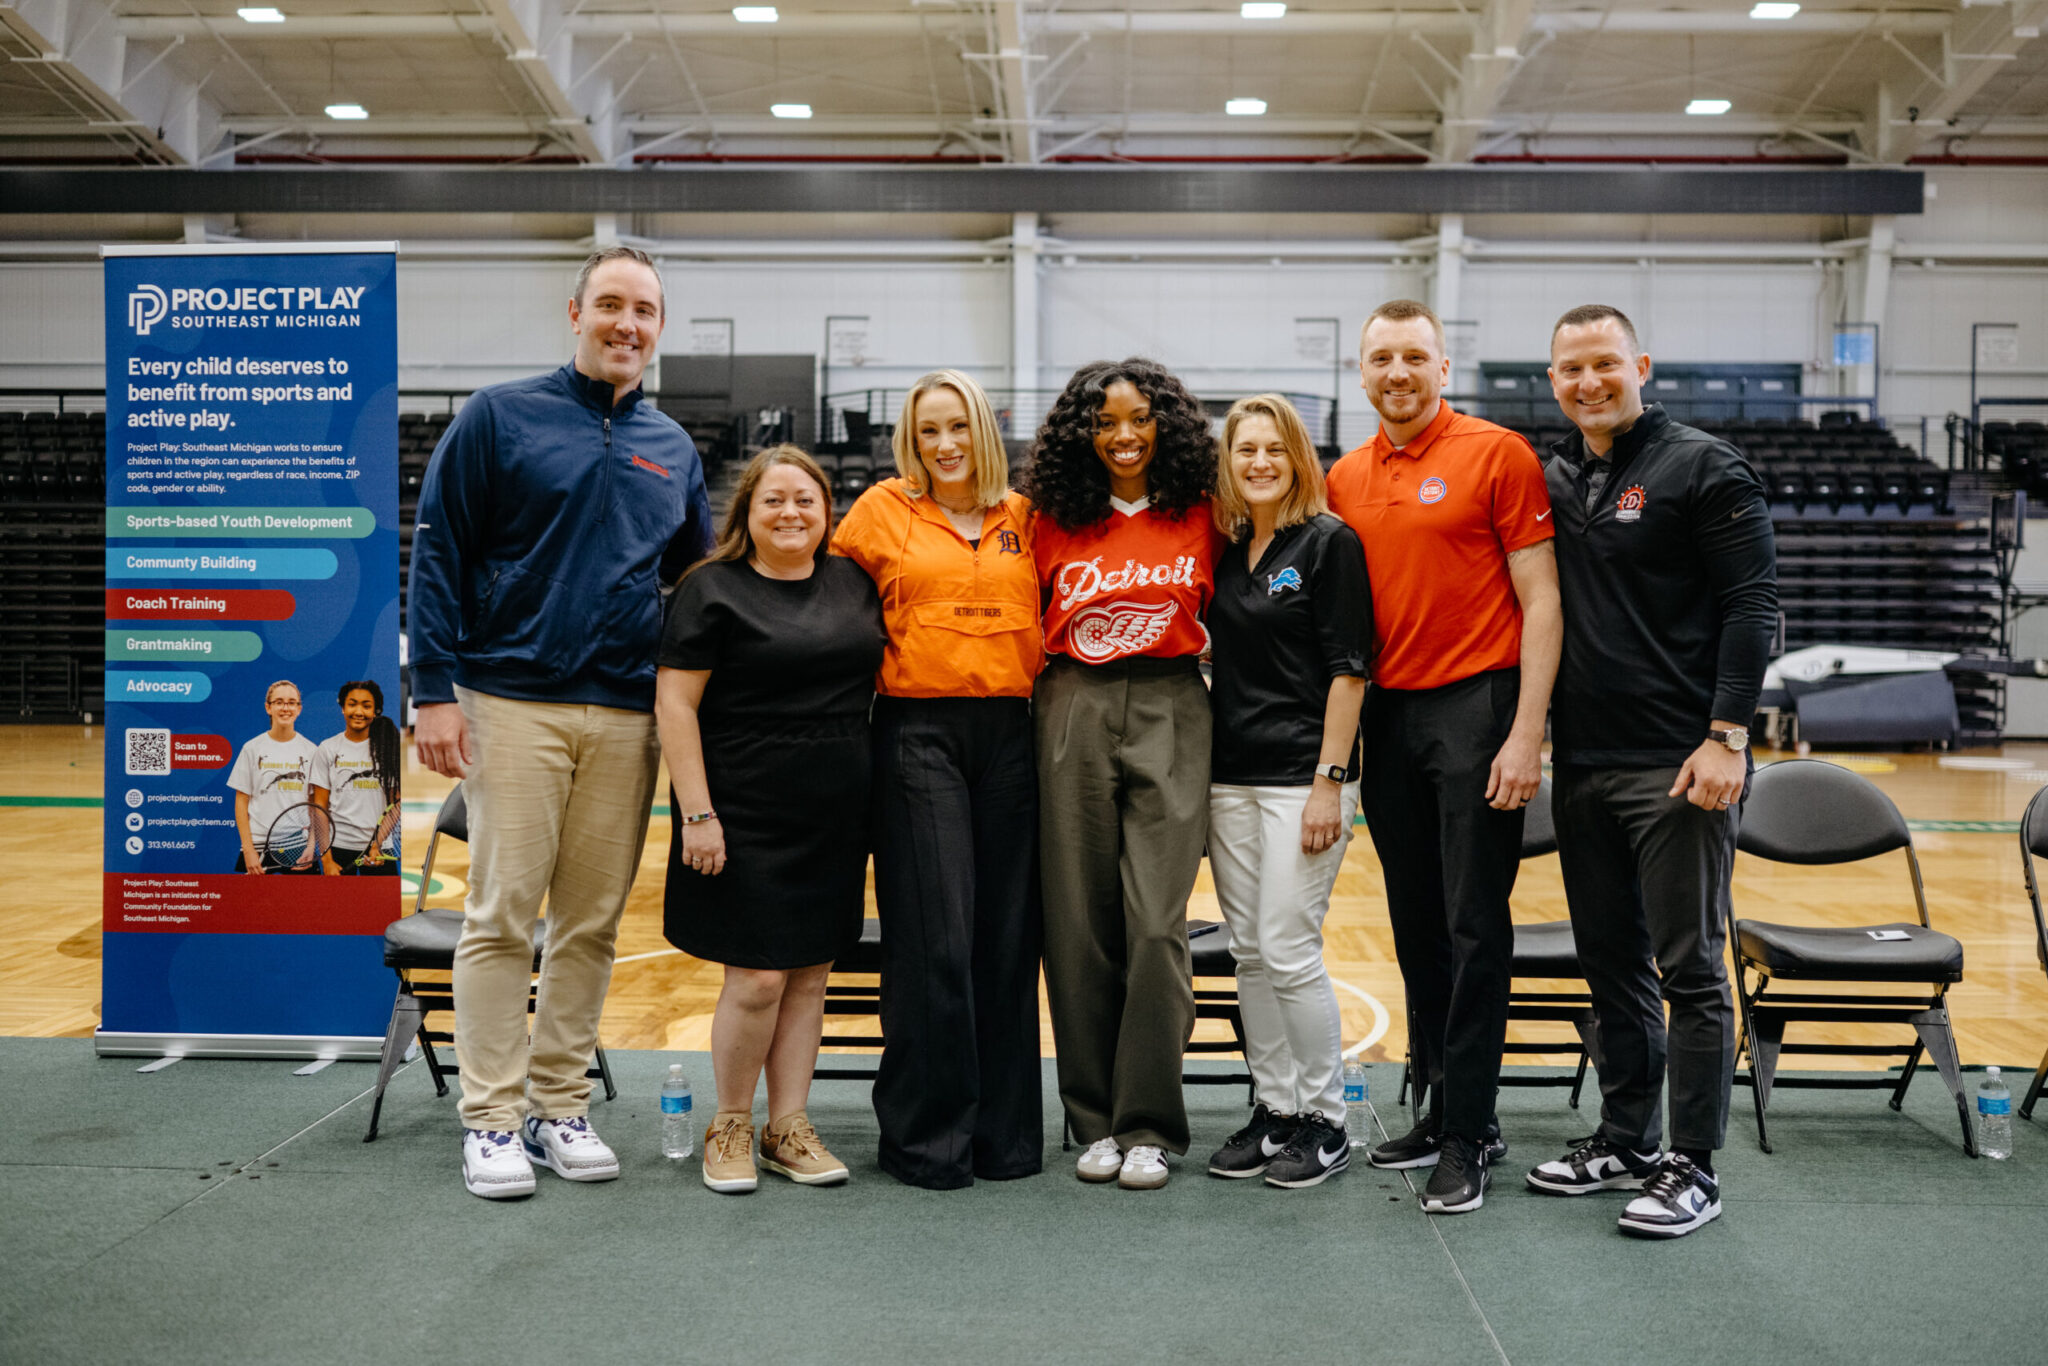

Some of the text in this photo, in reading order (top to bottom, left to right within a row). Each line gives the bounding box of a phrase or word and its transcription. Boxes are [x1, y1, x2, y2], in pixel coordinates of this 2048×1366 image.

[172, 287, 365, 310] PROJECT PLAY
[172, 315, 360, 328] SOUTHEAST MICHIGAN
[129, 357, 348, 379] Every child deserves to
[128, 383, 352, 405] benefit from sports and
[128, 409, 235, 431] active play.
[128, 443, 157, 453] Project
[160, 443, 180, 453] Play:
[183, 443, 227, 451] Southeast
[231, 443, 272, 453] Michigan
[274, 443, 299, 451] works
[127, 457, 162, 465] children
[164, 457, 173, 465] in
[174, 457, 189, 465] the
[191, 457, 220, 467] region
[241, 457, 290, 467] experience
[292, 457, 307, 465] the
[309, 457, 344, 465] benefits
[347, 456, 355, 465] of
[127, 471, 153, 480] sports
[156, 470, 172, 478] and
[175, 470, 201, 478] active
[204, 470, 224, 480] play,
[227, 471, 273, 480] regardless
[275, 470, 284, 479] of
[309, 471, 343, 479] income,
[346, 470, 360, 479] ZIP
[127, 484, 150, 492] code,
[152, 484, 184, 494] gender
[197, 484, 226, 494] ability.
[1625, 495, 1638, 508] D
[127, 515, 352, 530] Sports-based Youth Development
[997, 530, 1021, 555] D
[127, 556, 256, 571] Communty Building
[1058, 556, 1196, 611] Detroit
[127, 597, 225, 612] Coach Training
[954, 606, 1002, 617] DETROIT TIGERS
[127, 638, 211, 653] Grantmaking
[127, 680, 192, 695] Advocacy
[175, 742, 196, 750] Scan
[174, 753, 197, 761] learn
[123, 879, 147, 887] Project
[123, 891, 154, 899] Michigan
[123, 903, 162, 911] Community
[123, 914, 191, 924] Southeast Michigan.
